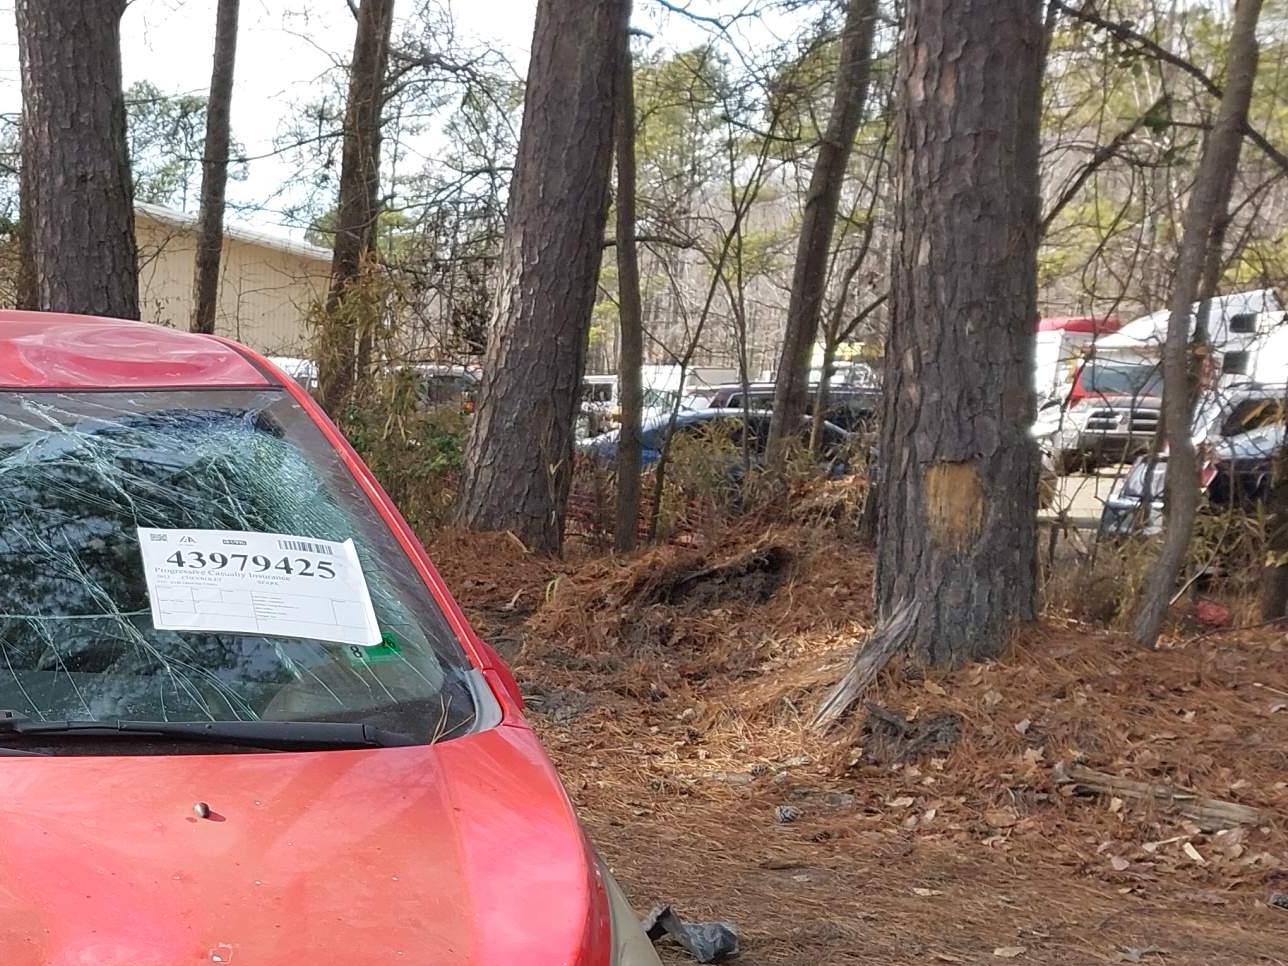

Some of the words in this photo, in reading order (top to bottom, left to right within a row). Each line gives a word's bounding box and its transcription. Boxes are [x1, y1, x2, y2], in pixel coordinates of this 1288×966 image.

[166, 549, 336, 580] 43979425
[155, 567, 206, 576] Progressive
[207, 569, 245, 579] Casualty
[249, 572, 291, 582] Insurance
[350, 645, 363, 658] 8
